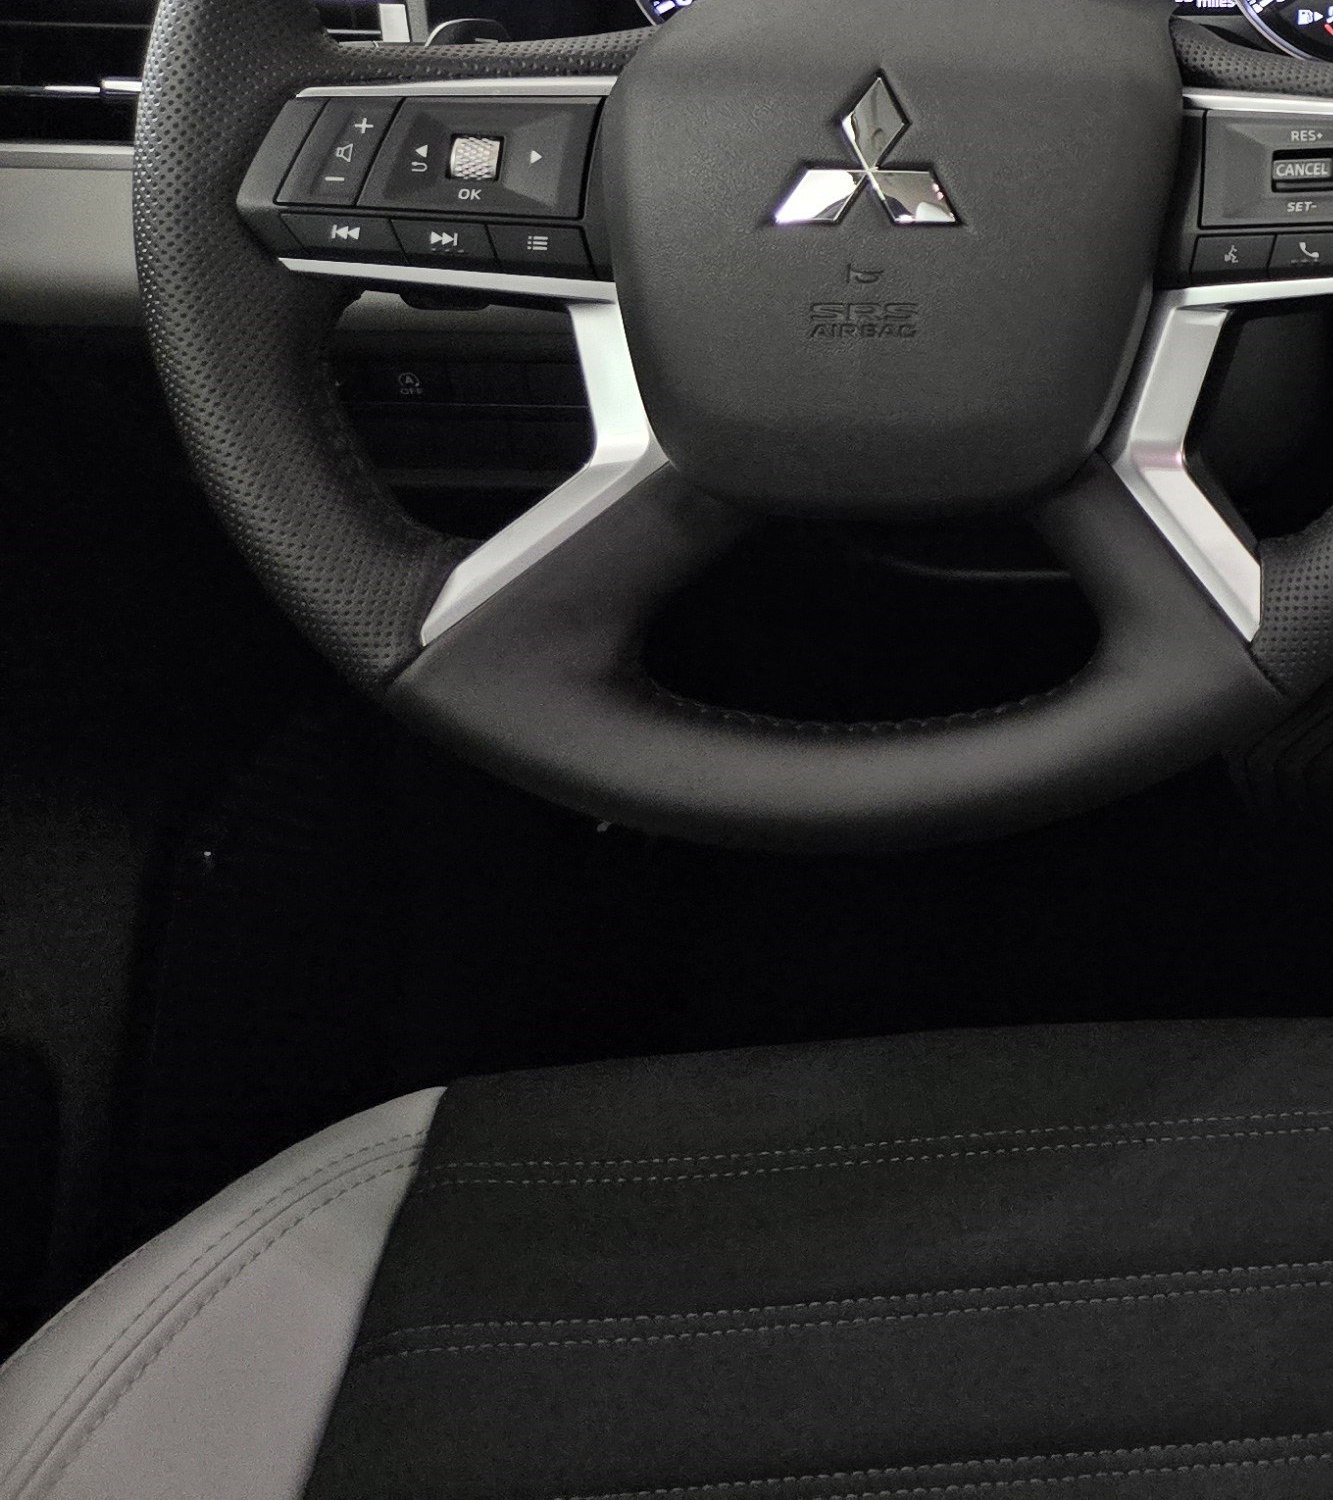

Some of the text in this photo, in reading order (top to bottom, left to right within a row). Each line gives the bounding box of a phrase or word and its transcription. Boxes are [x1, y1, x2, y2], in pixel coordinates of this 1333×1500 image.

[1275, 162, 1329, 177] CANCEL
[457, 187, 482, 201] OK
[810, 302, 918, 321] SRS
[810, 323, 917, 338] AIRBAG
